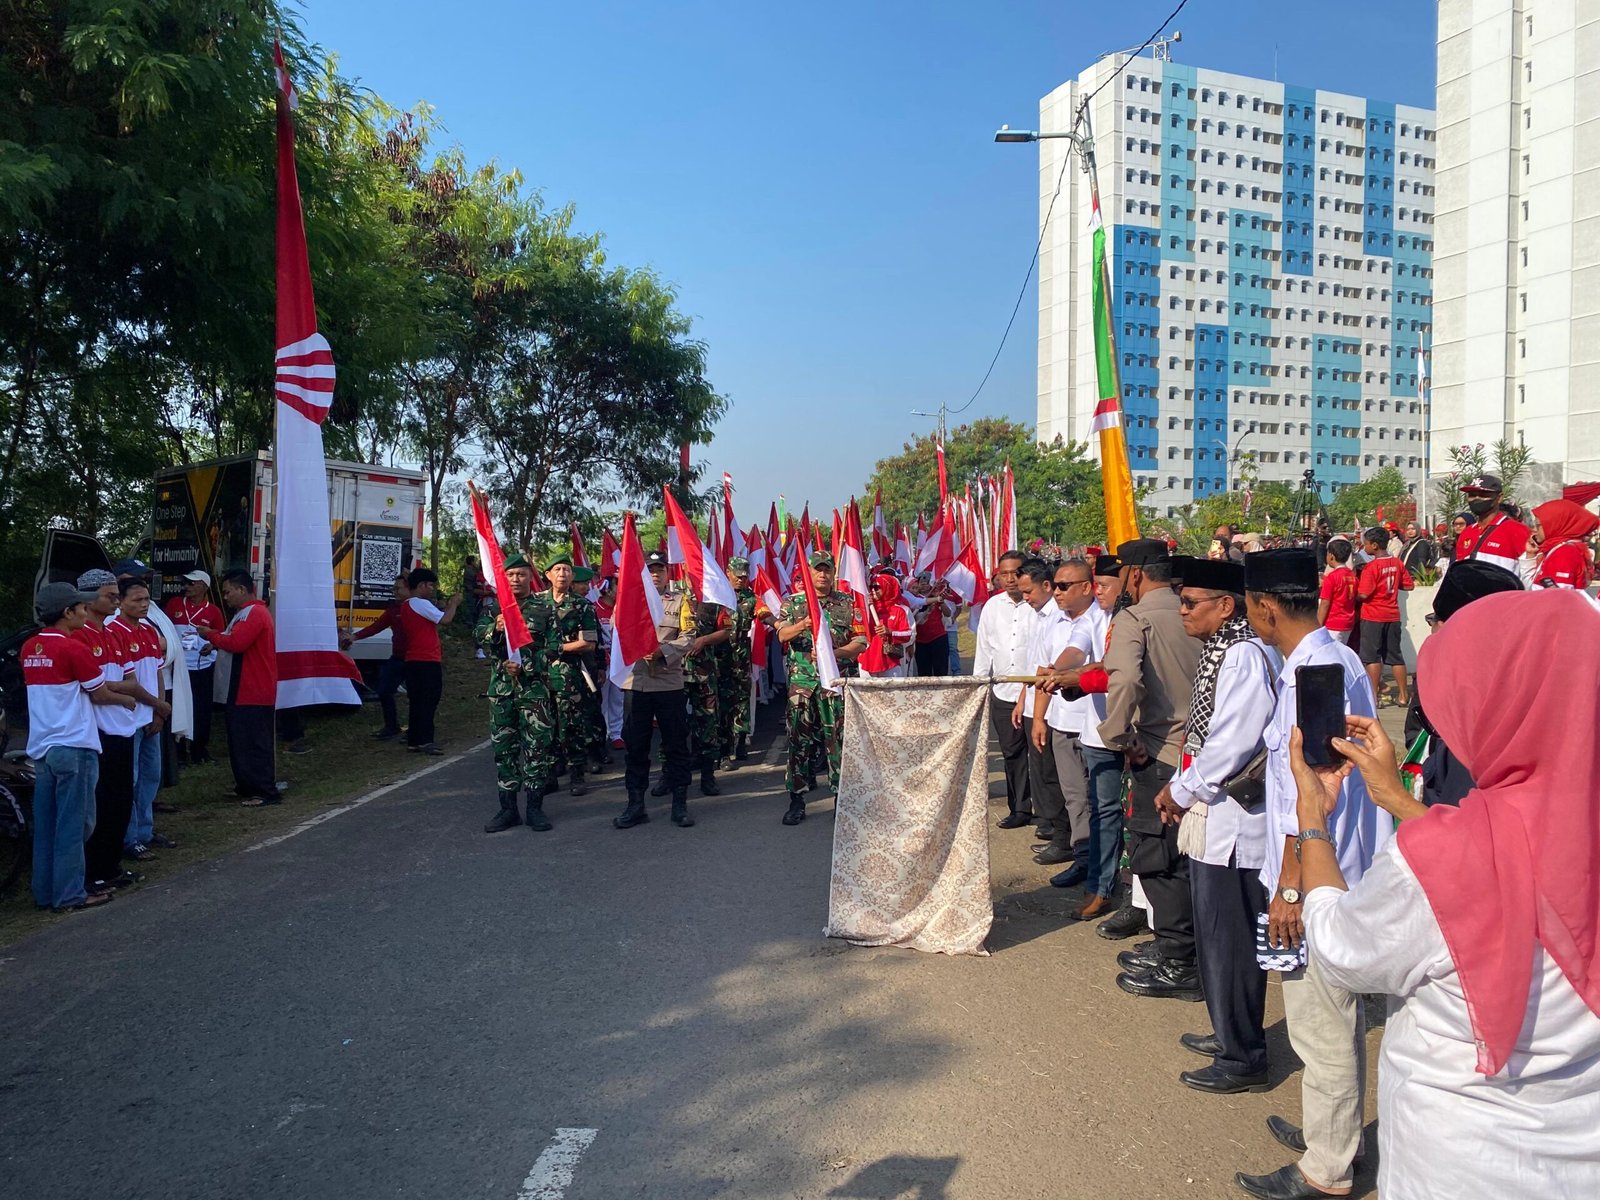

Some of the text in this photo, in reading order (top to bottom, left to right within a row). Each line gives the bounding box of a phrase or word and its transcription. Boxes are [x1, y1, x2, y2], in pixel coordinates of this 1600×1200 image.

[156, 505, 186, 522] One Step
[154, 545, 199, 566] for Humanity
